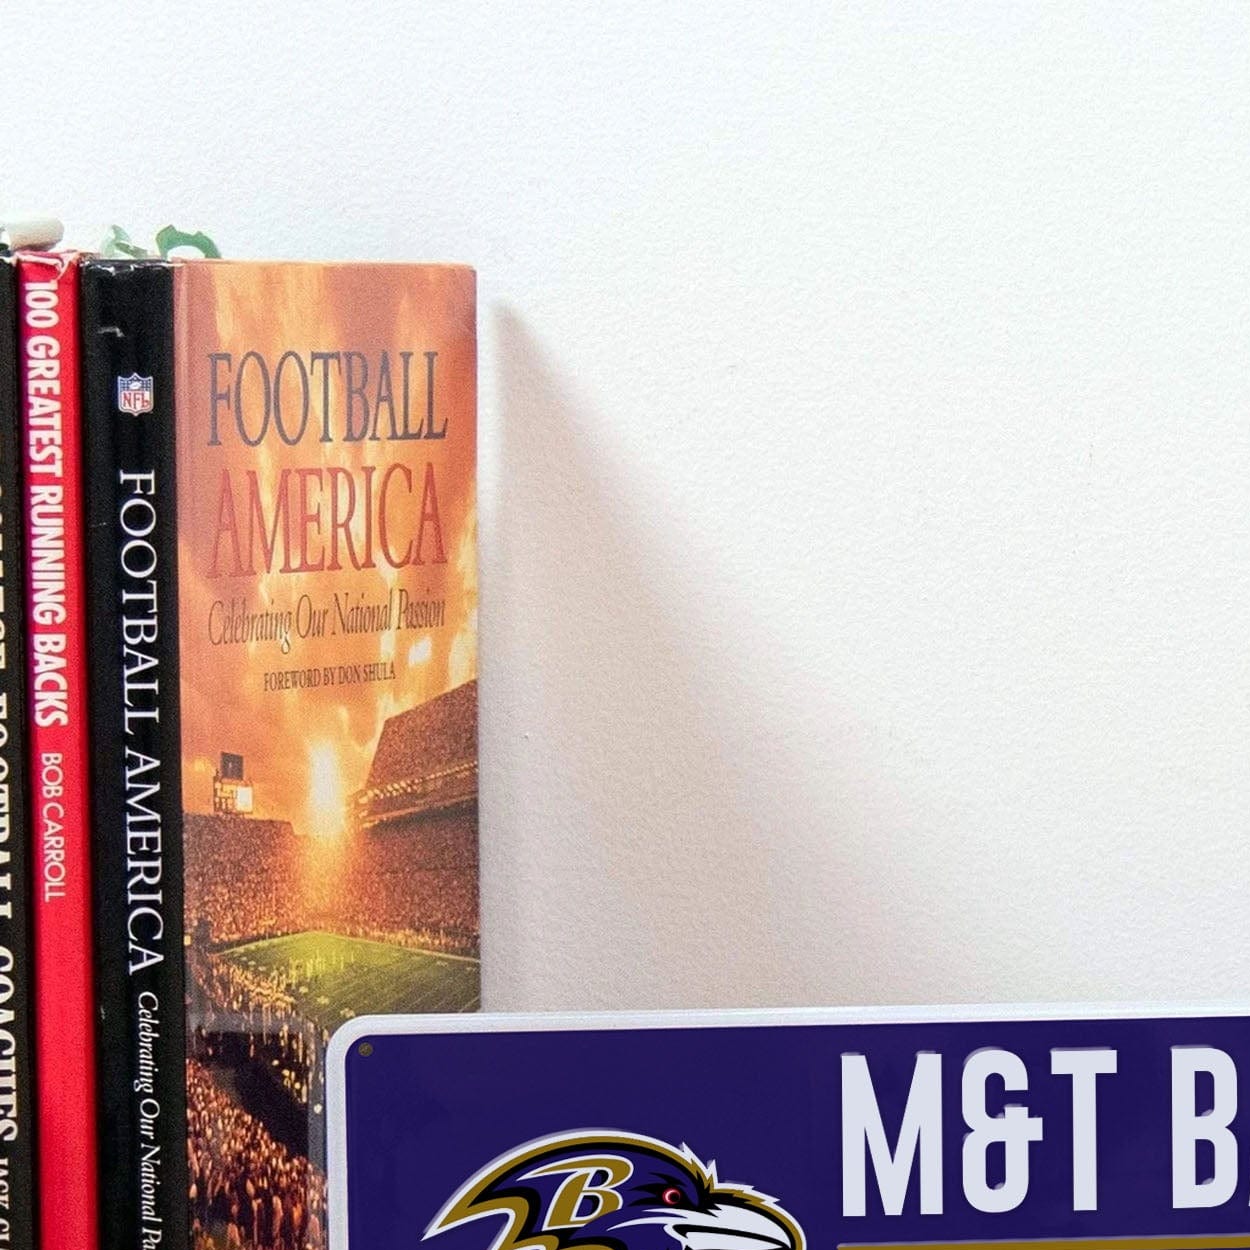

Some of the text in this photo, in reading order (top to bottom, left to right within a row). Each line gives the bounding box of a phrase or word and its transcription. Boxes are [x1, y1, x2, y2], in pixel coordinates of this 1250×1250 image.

[123, 391, 150, 410] NFL
[207, 350, 448, 446] FOOTBALL
[25, 280, 68, 727] 100 GREATEST RUNNING BACKS
[206, 461, 448, 578] AMERICA
[208, 587, 445, 655] Celebrating Our National Passion
[120, 470, 164, 975] FOOTBALL AMERICA
[264, 661, 396, 692] FOREWORD BY DON SHULA
[42, 753, 65, 902] BOB CARROLL
[134, 992, 159, 1093] Celebrating
[140, 1099, 160, 1139] Our
[842, 1049, 1117, 1216] M&T
[141, 1143, 162, 1222] National
